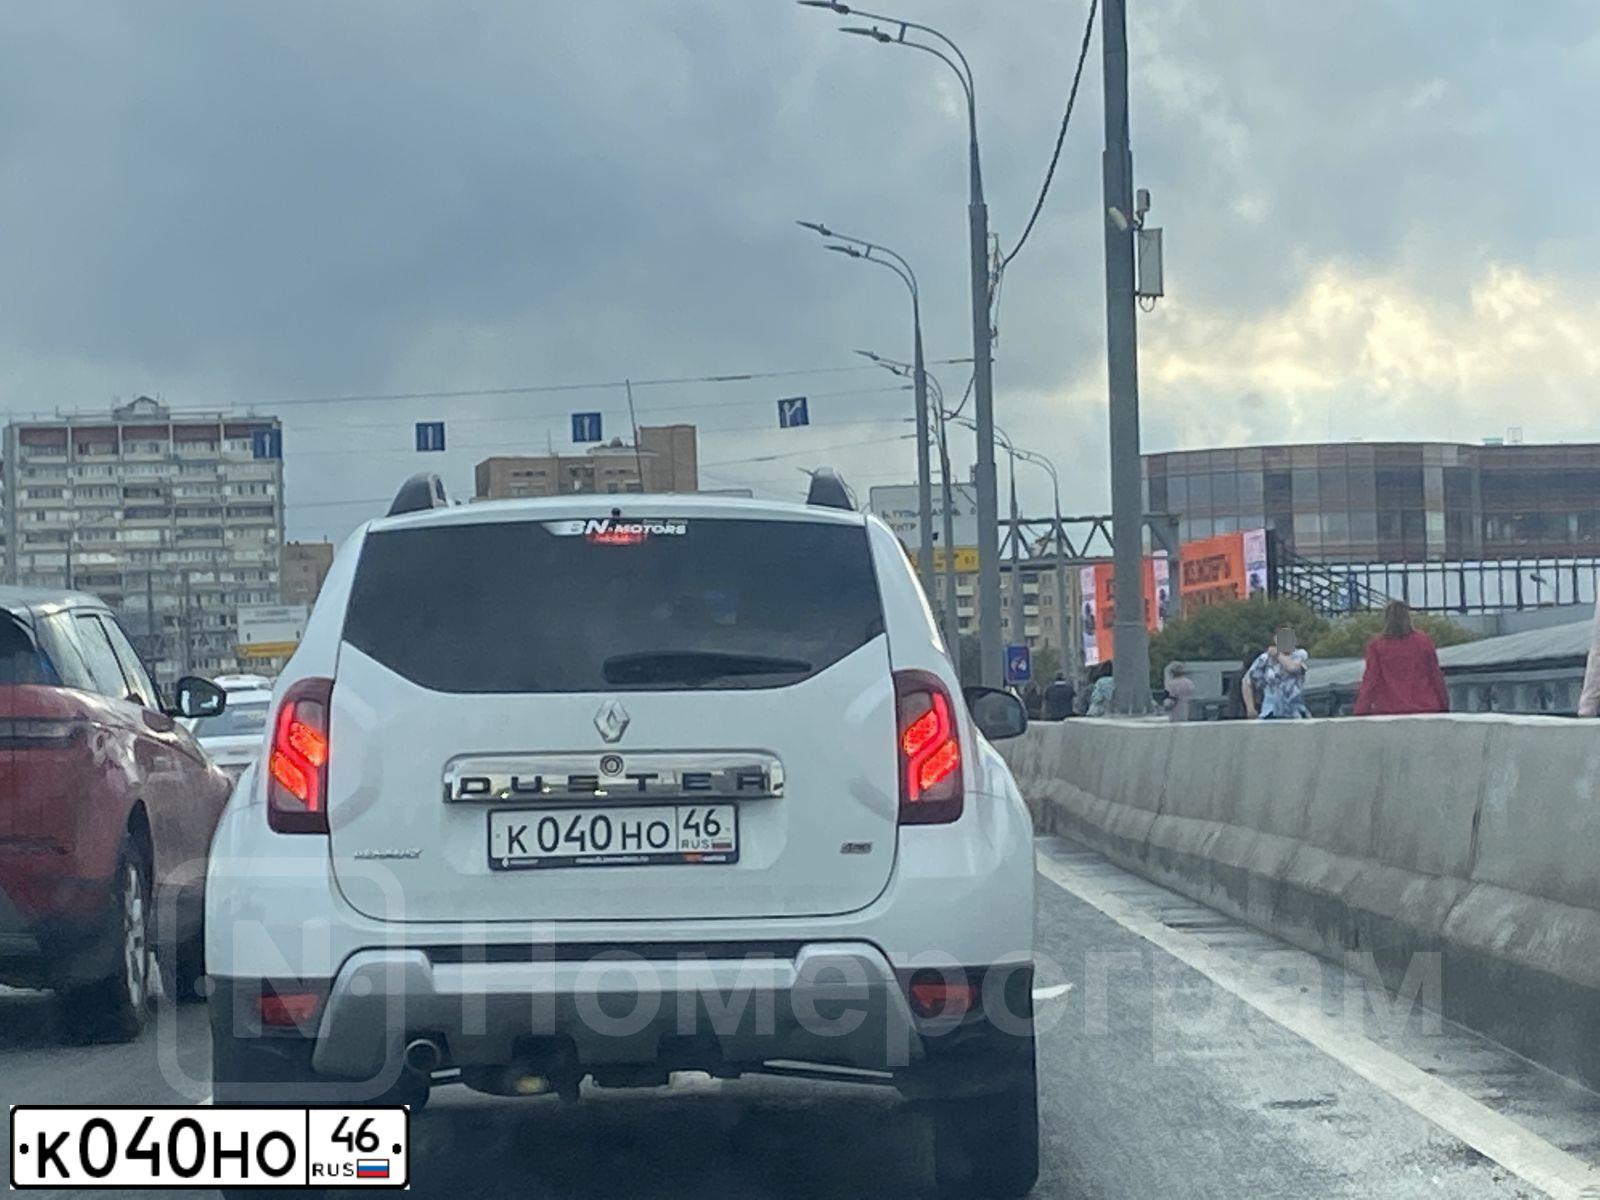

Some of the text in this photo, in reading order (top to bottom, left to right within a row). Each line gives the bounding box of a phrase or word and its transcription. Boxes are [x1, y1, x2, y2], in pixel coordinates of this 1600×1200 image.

[459, 773, 770, 795] DUSTER
[683, 808, 721, 837] 46
[681, 839, 711, 849] RUS
